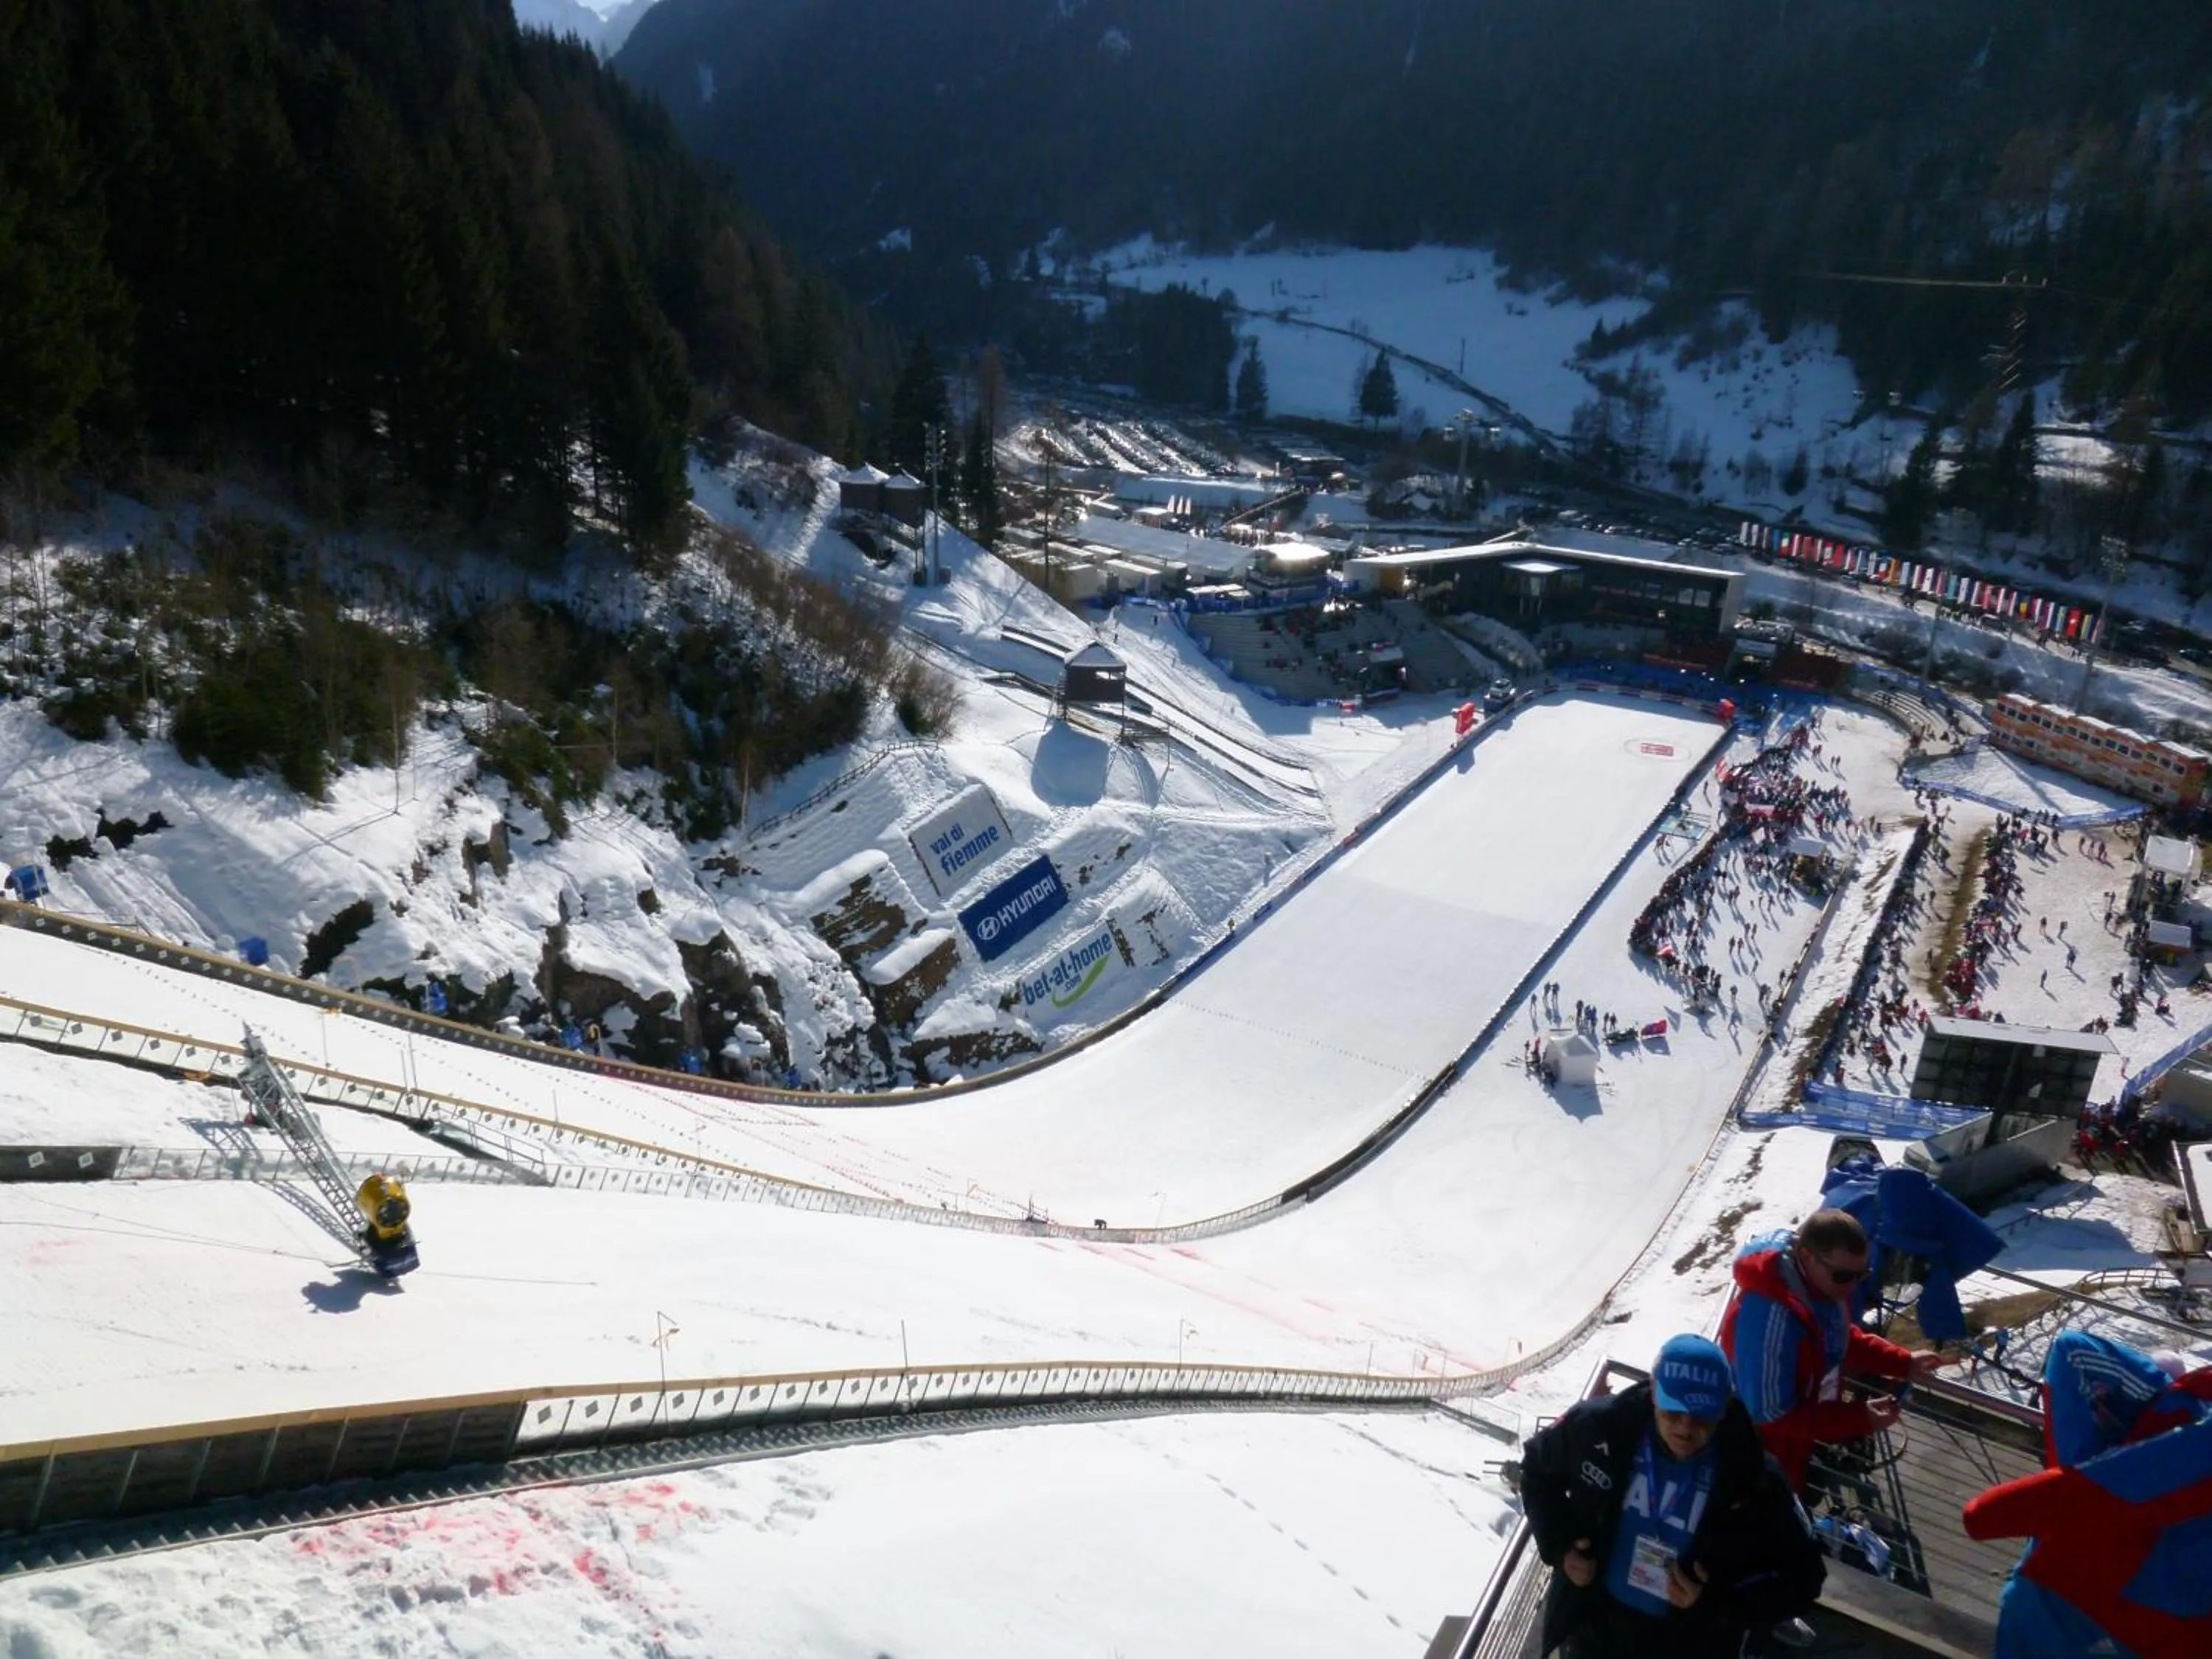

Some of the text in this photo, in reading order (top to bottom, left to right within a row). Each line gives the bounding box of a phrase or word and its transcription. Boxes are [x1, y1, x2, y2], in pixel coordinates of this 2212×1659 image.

[930, 823, 965, 855] val di
[940, 825, 1001, 877] fiemme
[996, 874, 1057, 928] HYUNDAI
[1021, 933, 1113, 1006] bet-at-home
[1664, 1360, 1719, 1388] ITALIA
